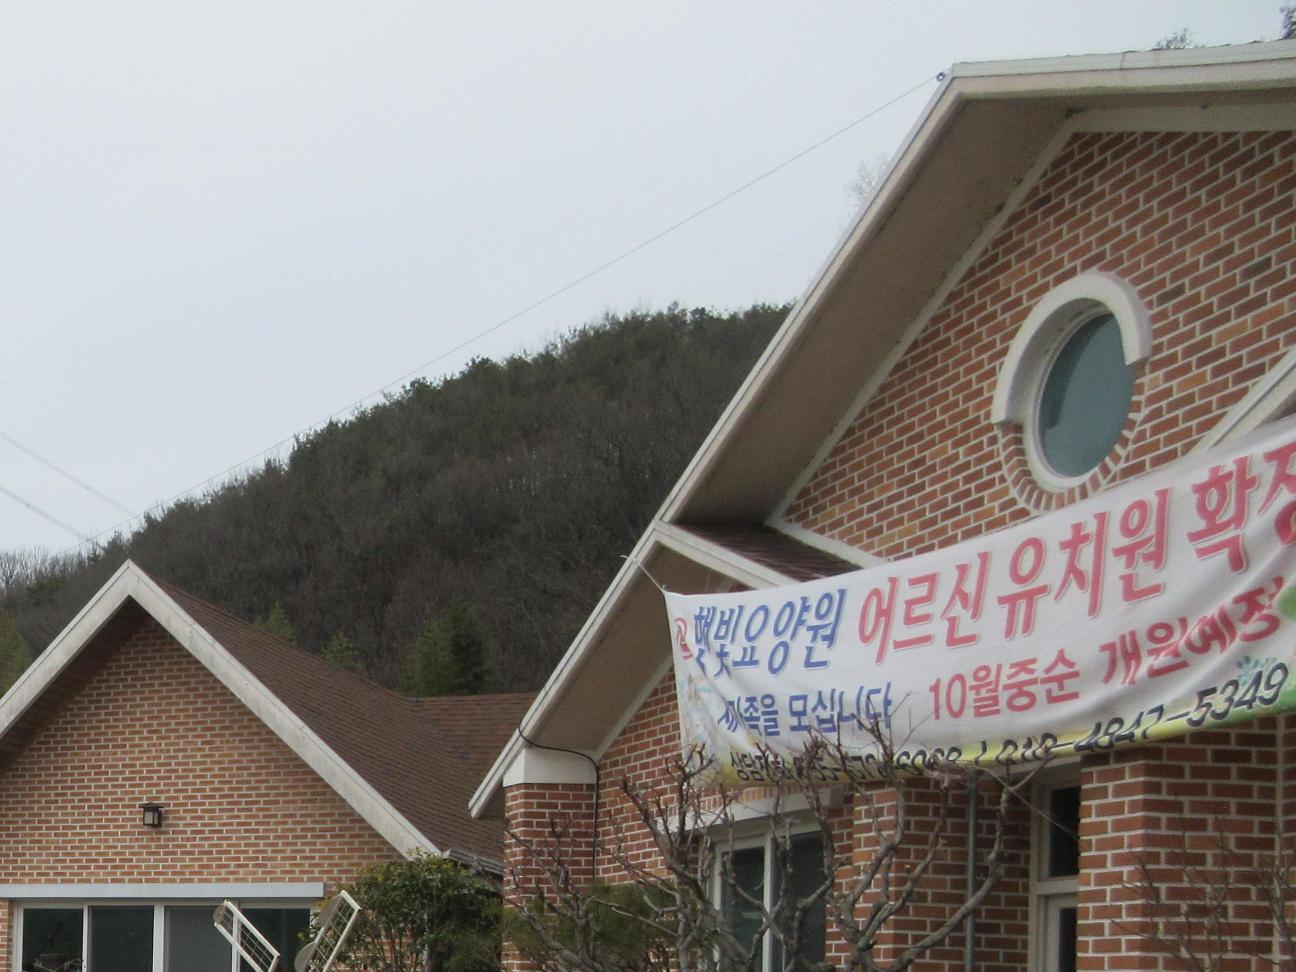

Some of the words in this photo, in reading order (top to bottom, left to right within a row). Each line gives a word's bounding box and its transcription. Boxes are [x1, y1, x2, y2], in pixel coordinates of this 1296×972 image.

[693, 588, 847, 678] 햇빛요양원
[858, 551, 992, 666] 어르신
[996, 486, 1173, 641] 유치원
[929, 648, 1081, 720] 10월중순
[1098, 575, 1285, 686] 개원예정
[789, 681, 893, 734] 모십니다
